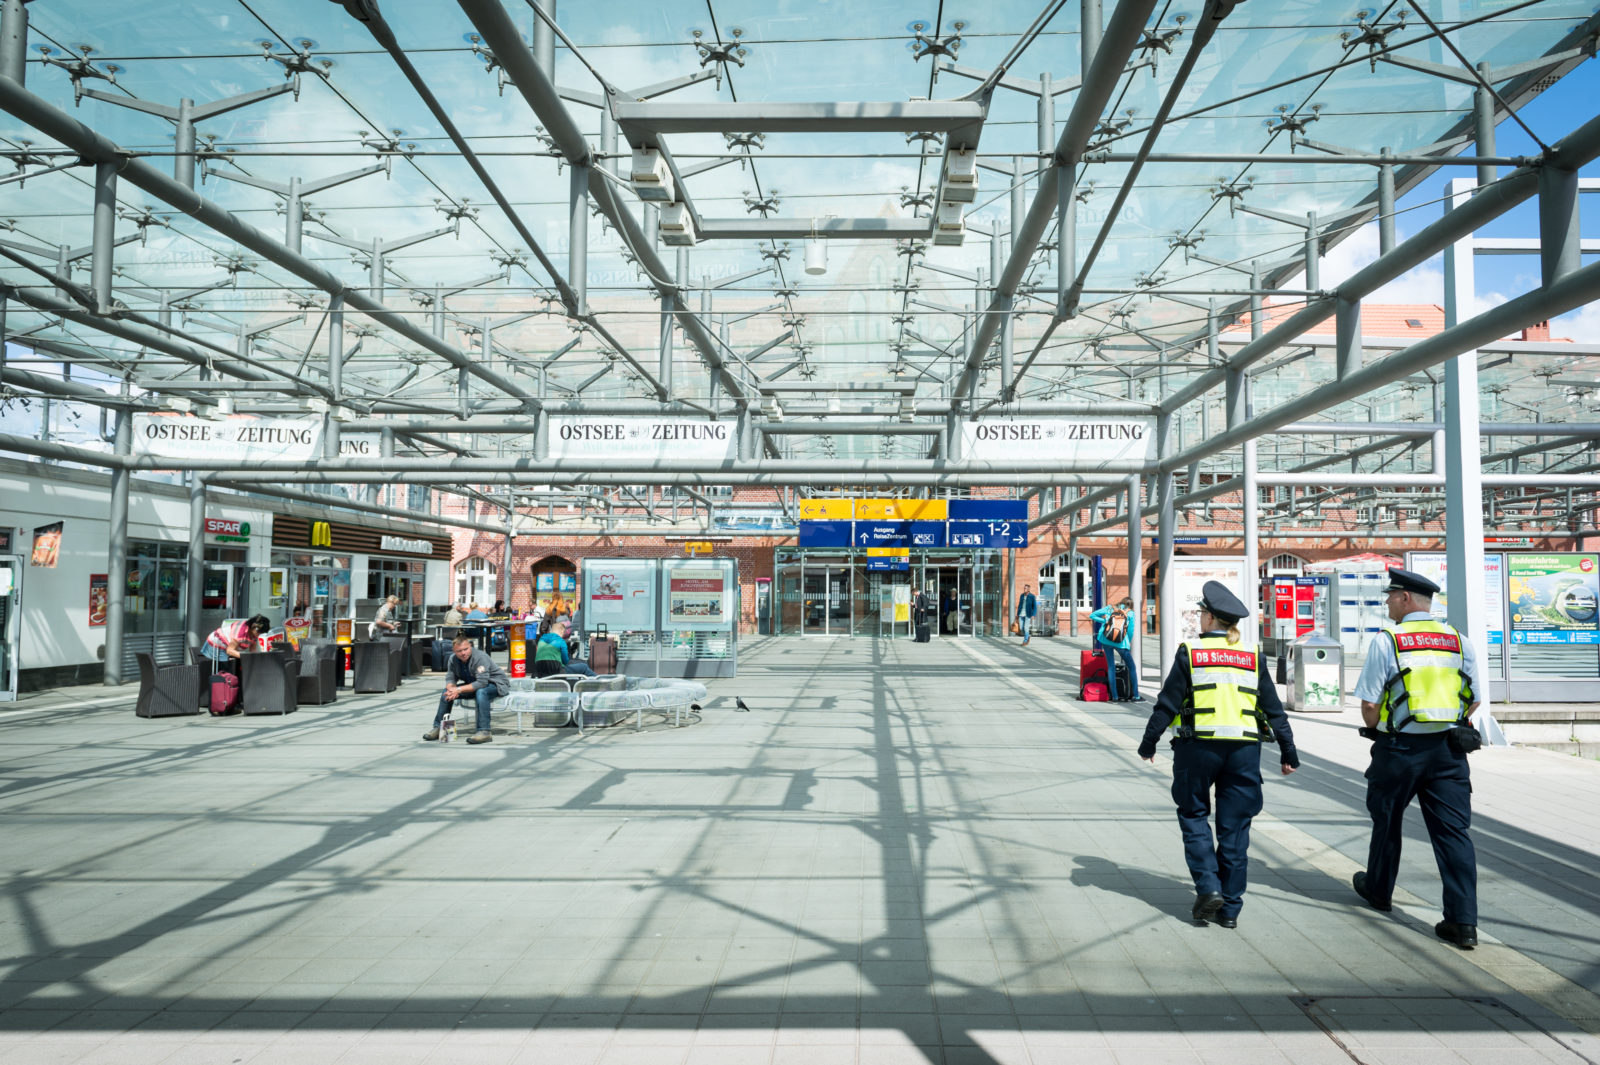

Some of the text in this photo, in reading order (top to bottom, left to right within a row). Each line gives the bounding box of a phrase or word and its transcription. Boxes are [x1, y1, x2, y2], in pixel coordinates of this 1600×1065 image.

[146, 423, 312, 444] OSTSEE ZEITUNG
[560, 424, 726, 440] OSTSEE ZEITUNG
[976, 424, 1143, 440] OSTSEE ZEITUNG
[208, 520, 240, 533] SPAR
[987, 523, 1010, 536] 1-2
[1401, 634, 1457, 648] DB Sicherheit
[1196, 652, 1252, 667] DB Sicherheit
